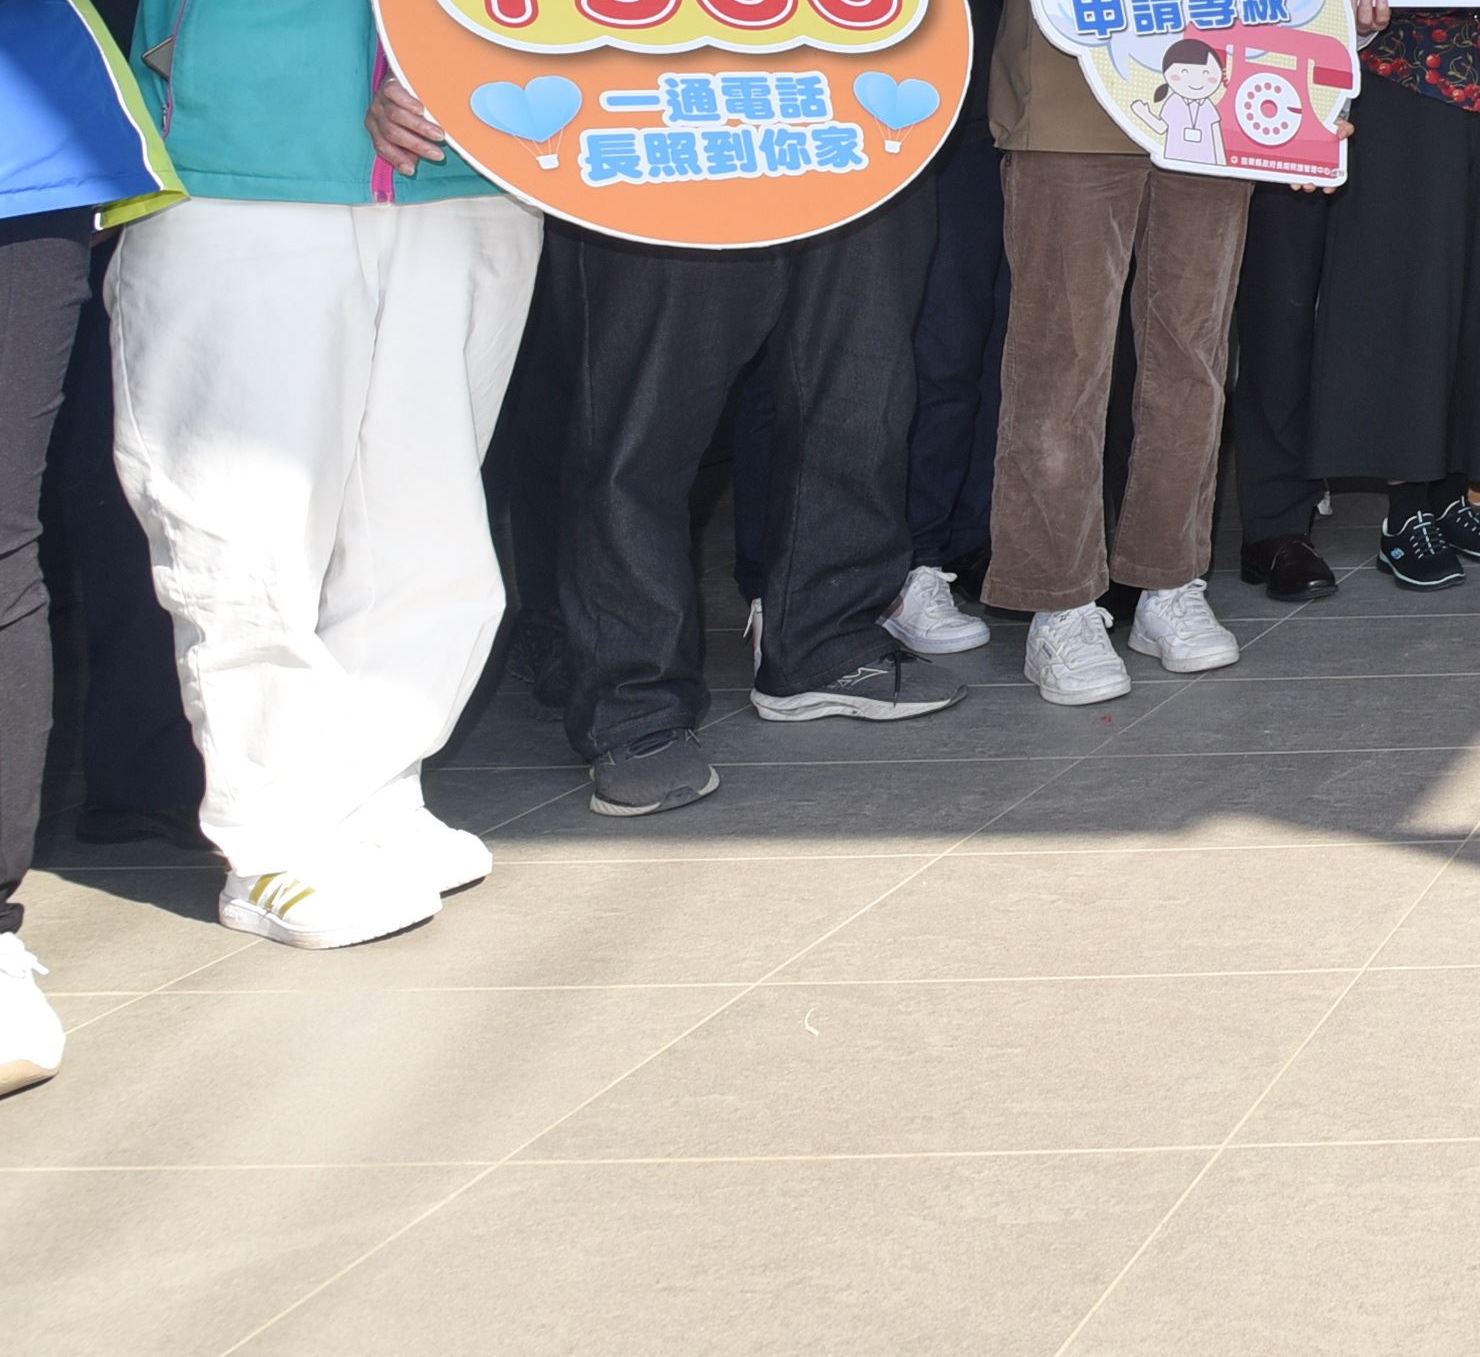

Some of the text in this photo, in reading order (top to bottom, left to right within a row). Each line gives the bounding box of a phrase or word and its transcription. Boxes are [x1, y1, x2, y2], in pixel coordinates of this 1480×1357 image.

[603, 73, 830, 124] 一通電話
[582, 127, 866, 184] 長照到你家
